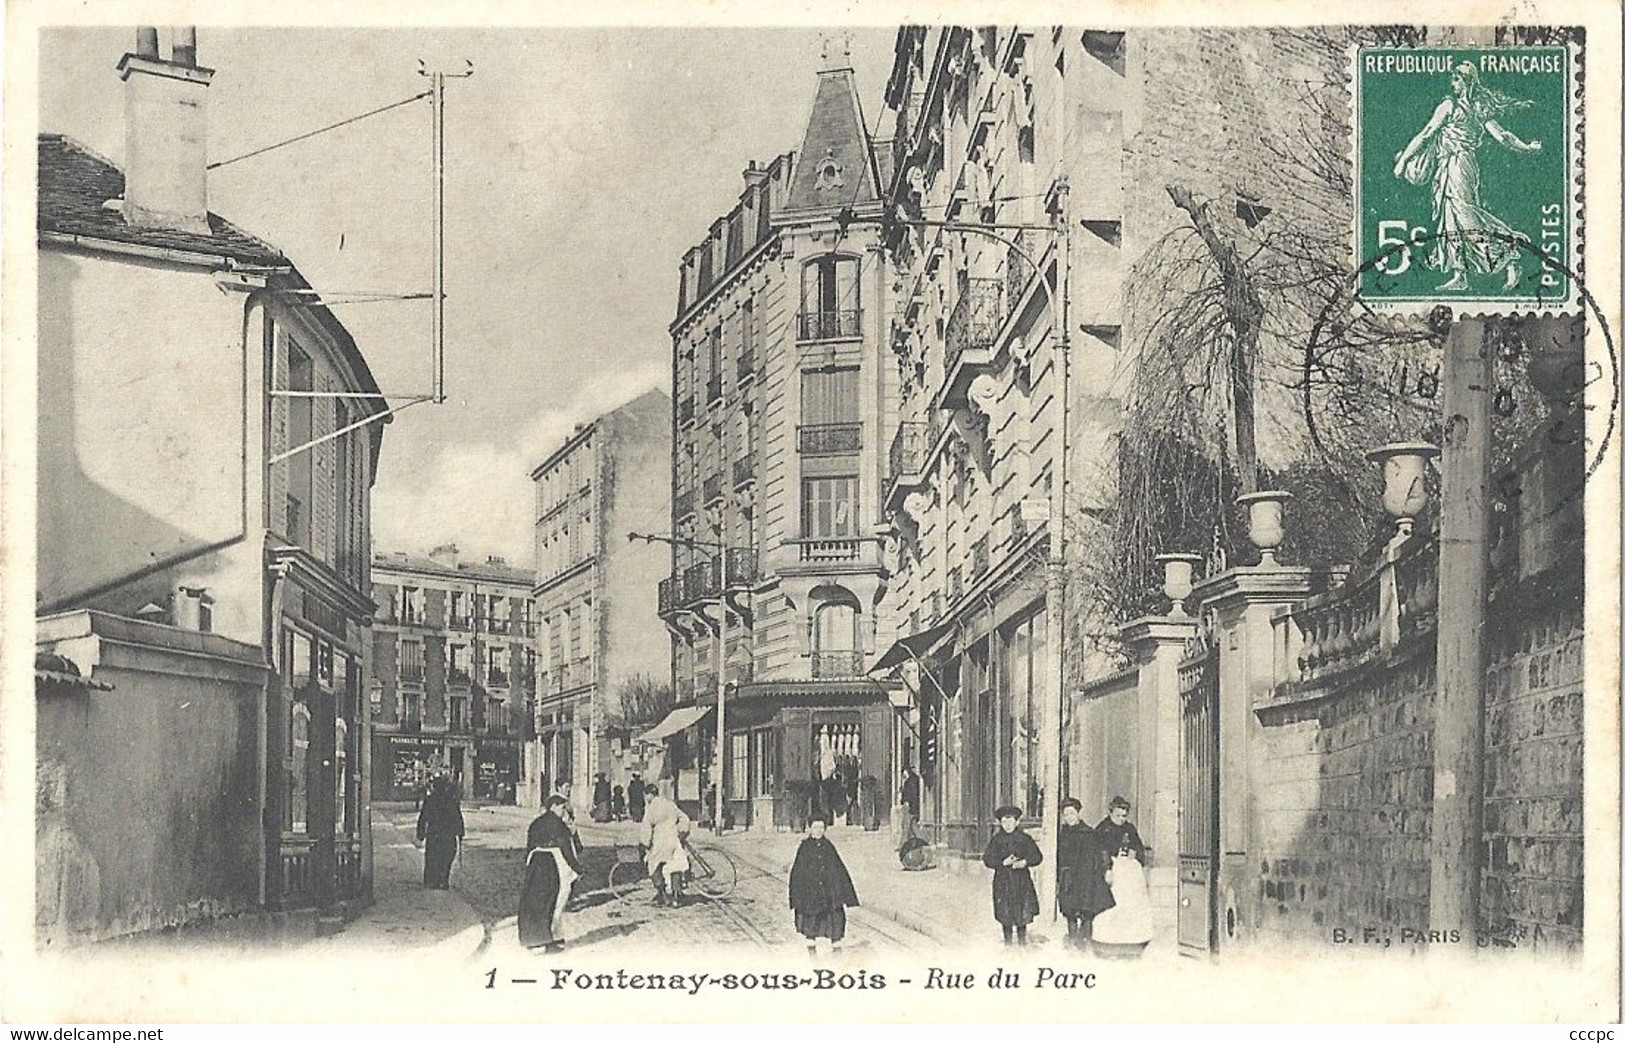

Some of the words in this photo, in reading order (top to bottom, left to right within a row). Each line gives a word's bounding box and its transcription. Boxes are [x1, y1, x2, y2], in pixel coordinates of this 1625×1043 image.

[1365, 55, 1453, 76] REPUBLIQUE
[1480, 55, 1561, 76] FRANÇAISE
[1541, 203, 1562, 287] POSTES
